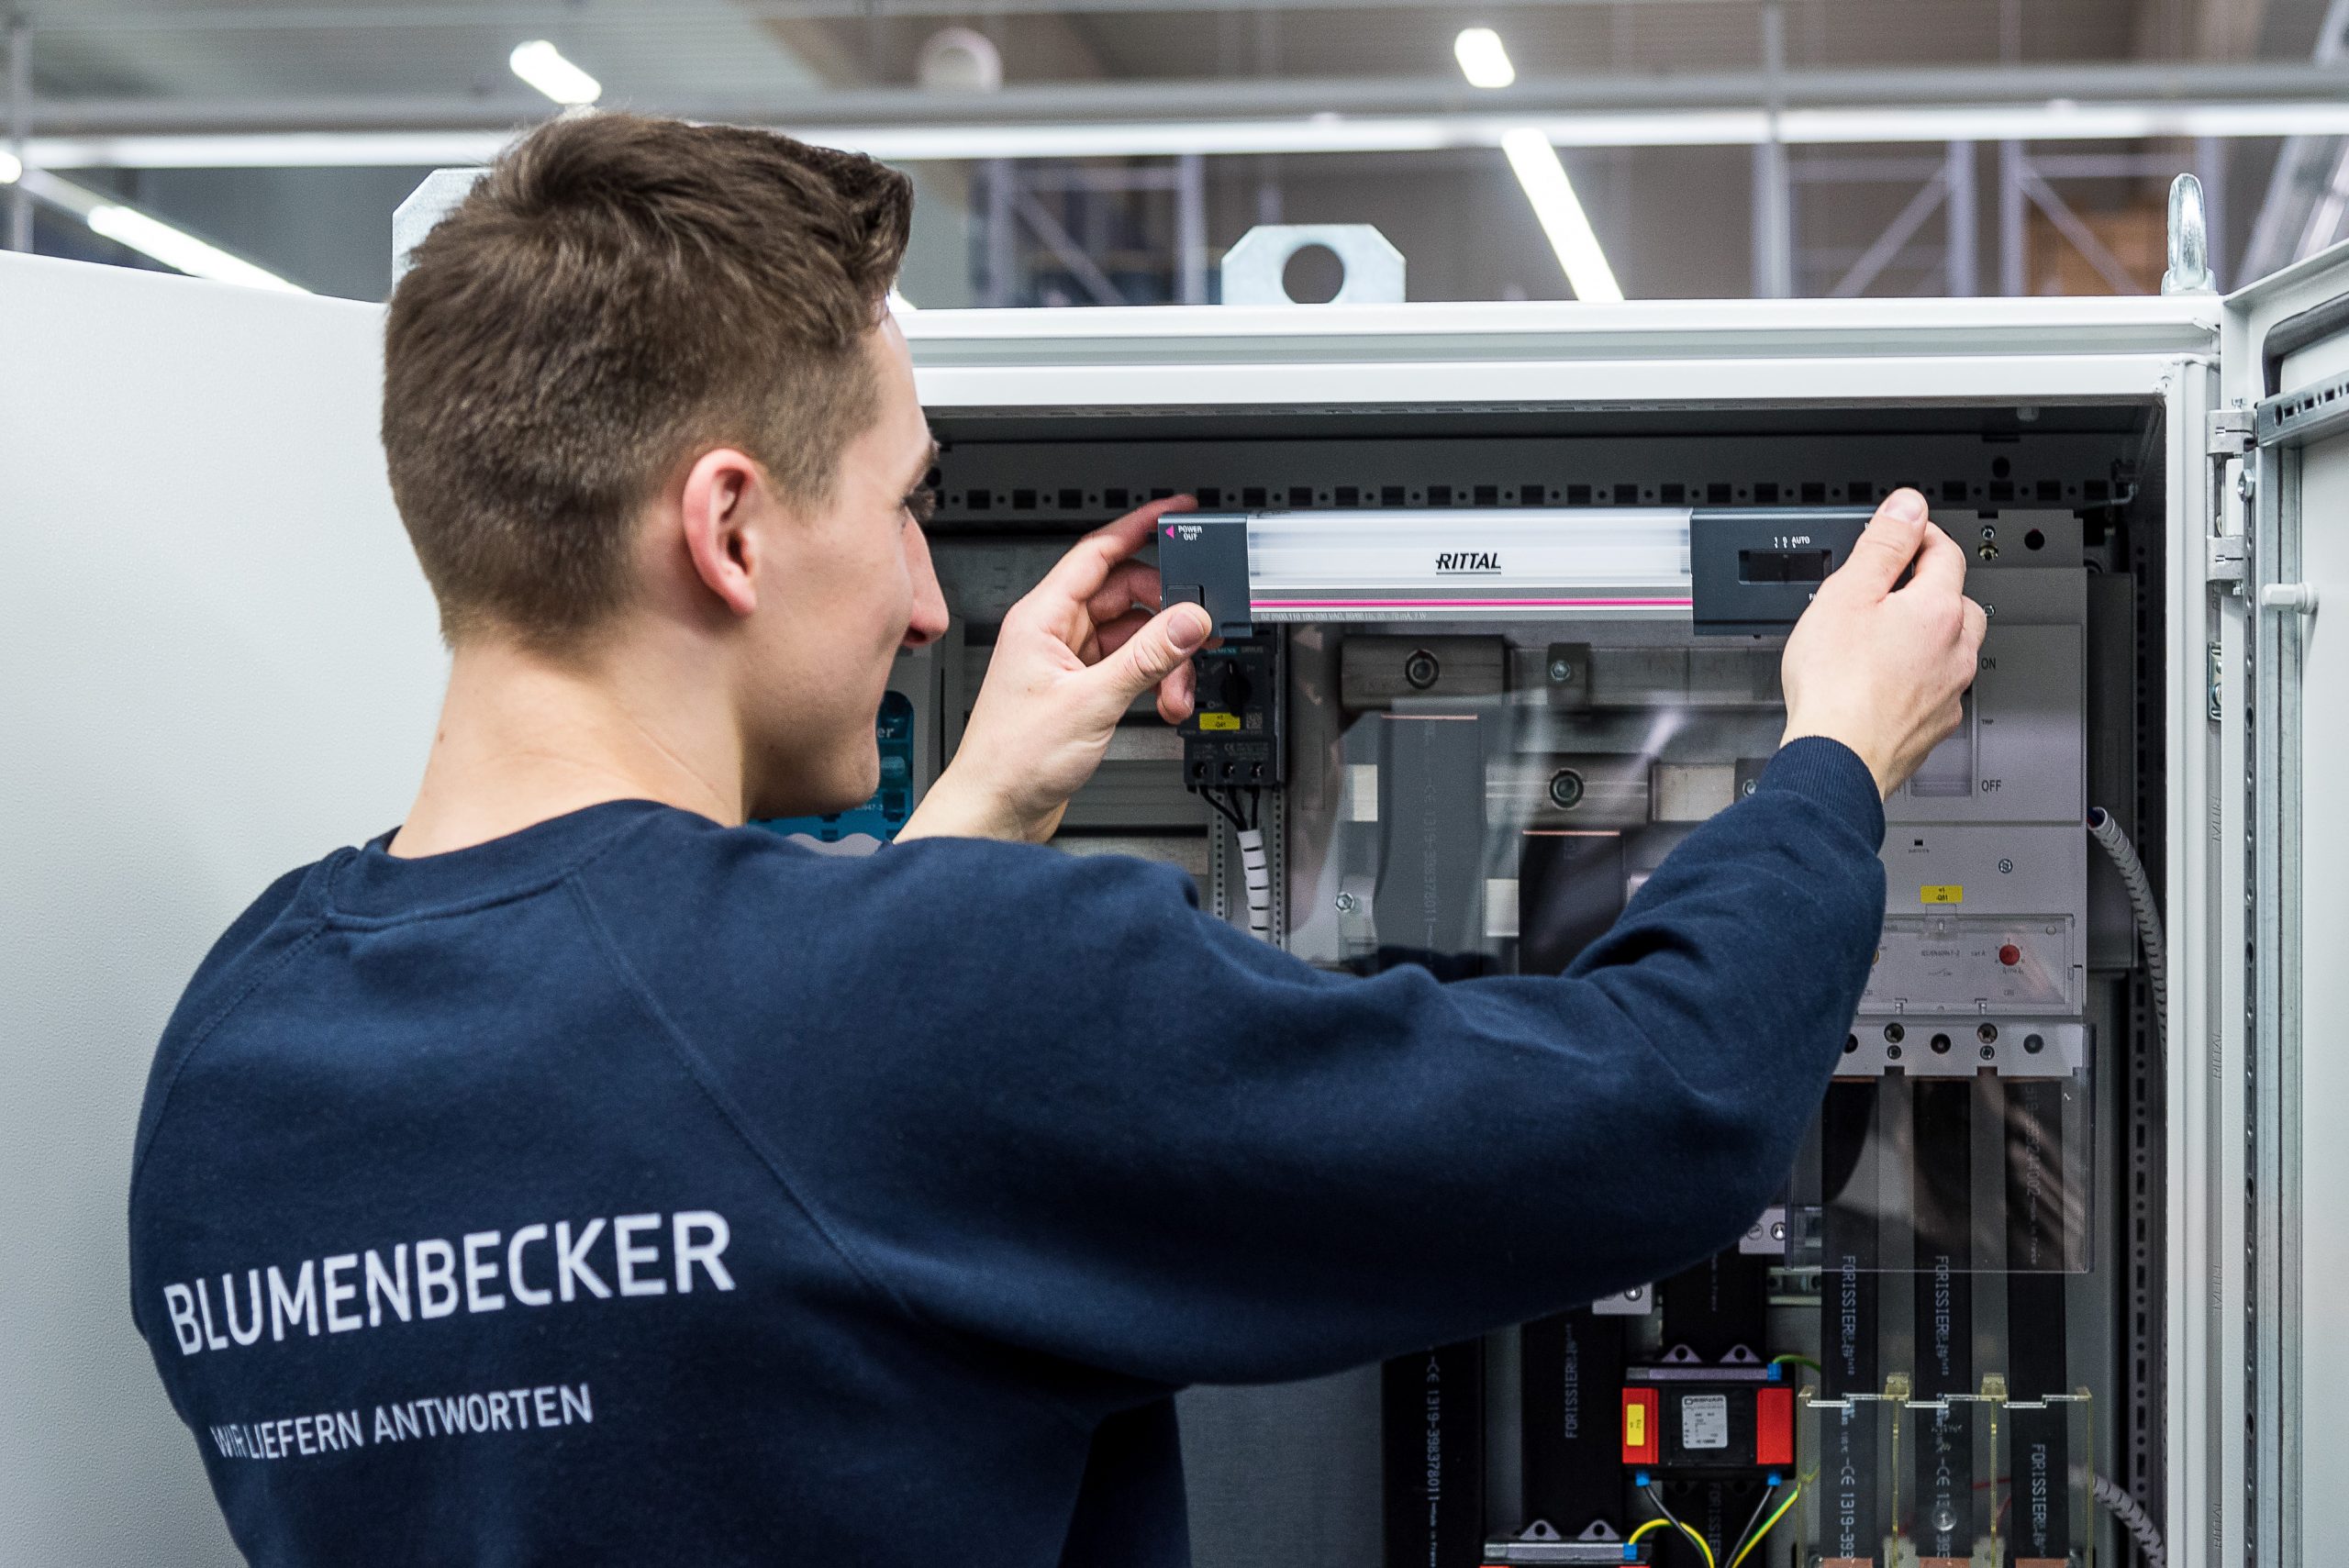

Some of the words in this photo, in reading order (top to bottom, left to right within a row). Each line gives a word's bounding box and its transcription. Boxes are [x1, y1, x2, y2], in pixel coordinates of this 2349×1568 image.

[1178, 525, 1203, 534] POWER
[1183, 533, 1198, 541] OUT
[1791, 536, 1810, 544] AUTO
[1435, 552, 1501, 570] RITTAL
[1981, 658, 1996, 671] ON
[1981, 780, 2002, 793] OFF
[163, 1209, 736, 1355] BLUMENBECKER
[1842, 1254, 1855, 1334] FORISSIER
[1935, 1254, 1949, 1334] FORISSIER
[209, 1424, 247, 1458] WIR
[243, 1409, 364, 1460] LIEFERN
[373, 1383, 593, 1444] ANTWORTEN
[1565, 1364, 1578, 1439] FORISSIER
[2032, 1443, 2046, 1520] FORISSIER
